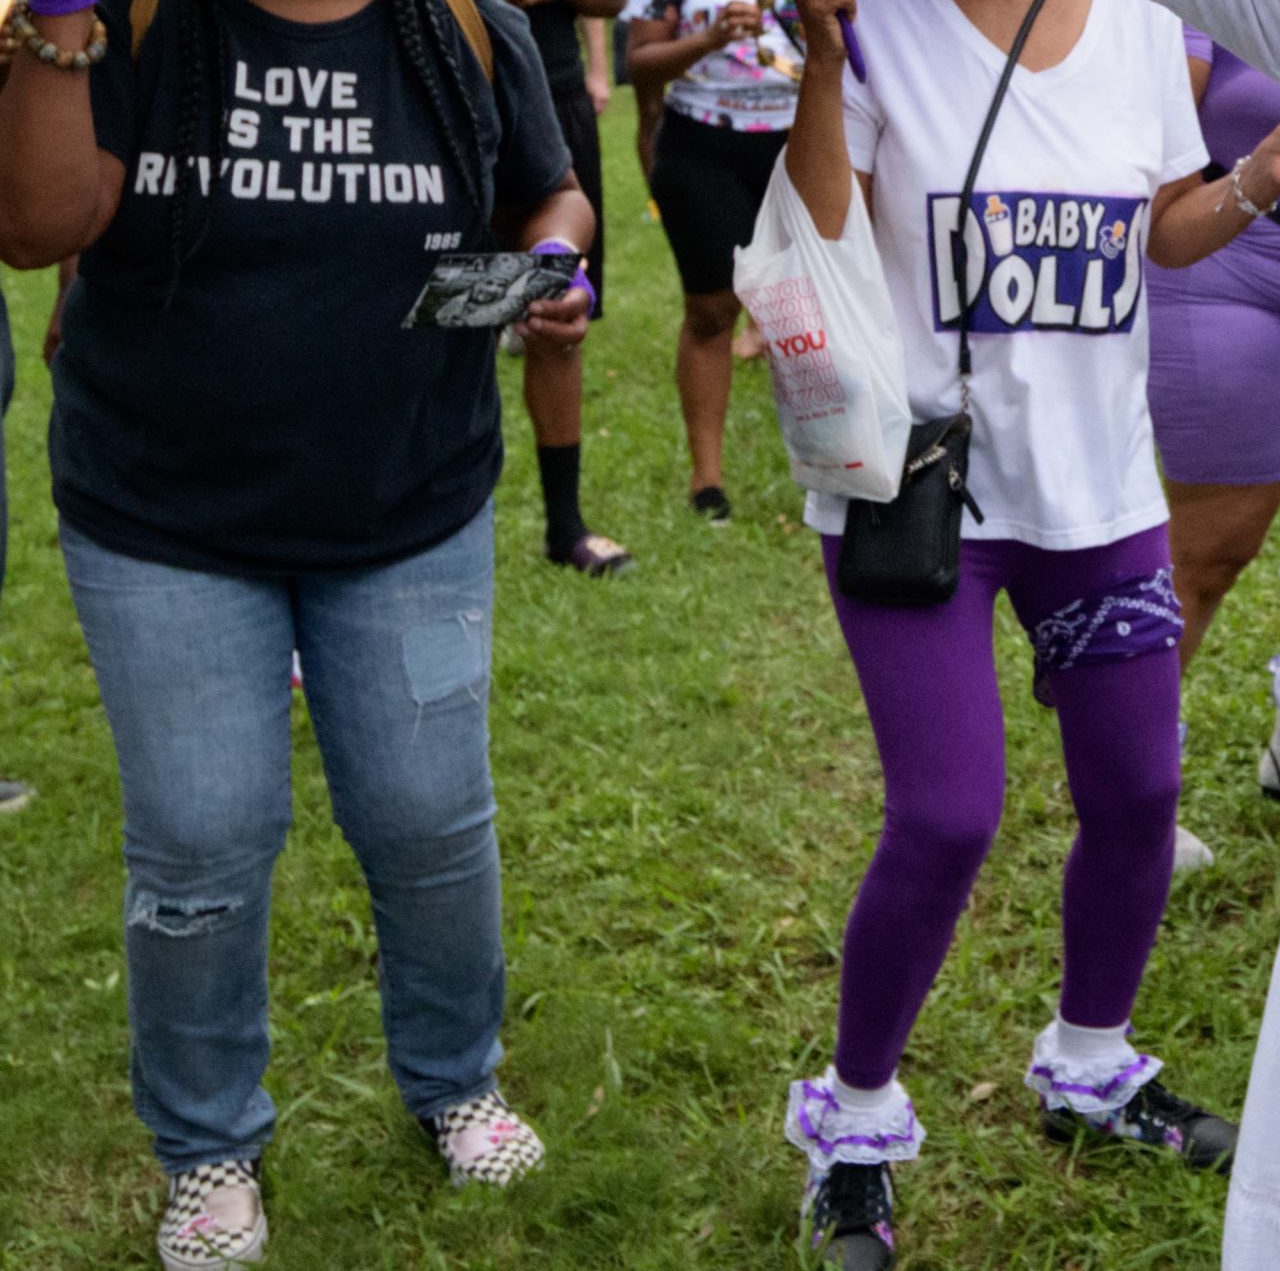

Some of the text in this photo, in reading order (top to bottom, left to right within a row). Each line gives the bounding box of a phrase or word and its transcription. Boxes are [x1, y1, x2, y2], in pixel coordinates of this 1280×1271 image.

[235, 61, 357, 109] LOVE
[223, 107, 373, 154] S THE
[1015, 197, 1106, 251] BABY
[776, 329, 827, 358] YOU
